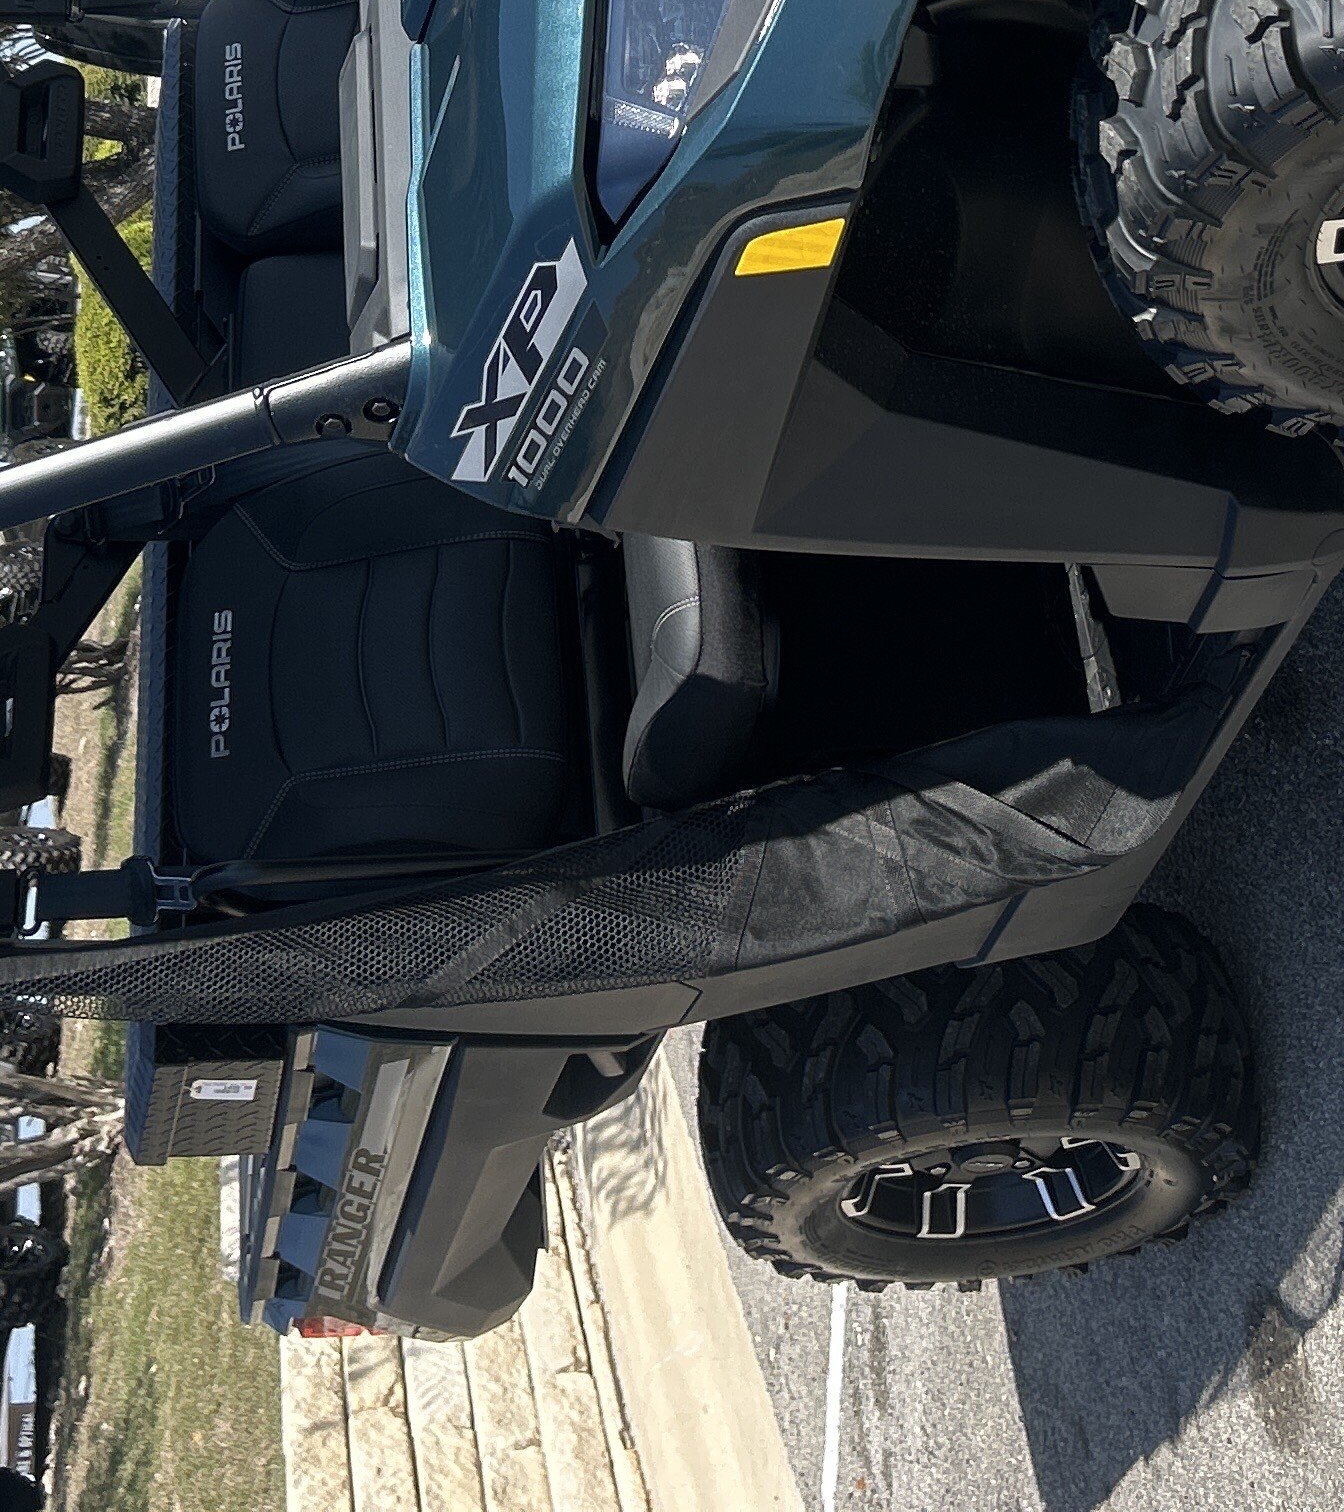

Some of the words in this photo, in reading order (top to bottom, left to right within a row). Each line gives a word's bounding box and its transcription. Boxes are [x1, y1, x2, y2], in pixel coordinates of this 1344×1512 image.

[223, 42, 246, 152] POLARIS
[449, 260, 566, 482] XP
[507, 346, 590, 488] 1000
[533, 456, 558, 492] DUAL
[552, 388, 592, 458] OVERHEAD
[586, 358, 607, 391] CAM
[209, 609, 233, 758] POLARIS
[314, 1146, 389, 1295] RANGER
